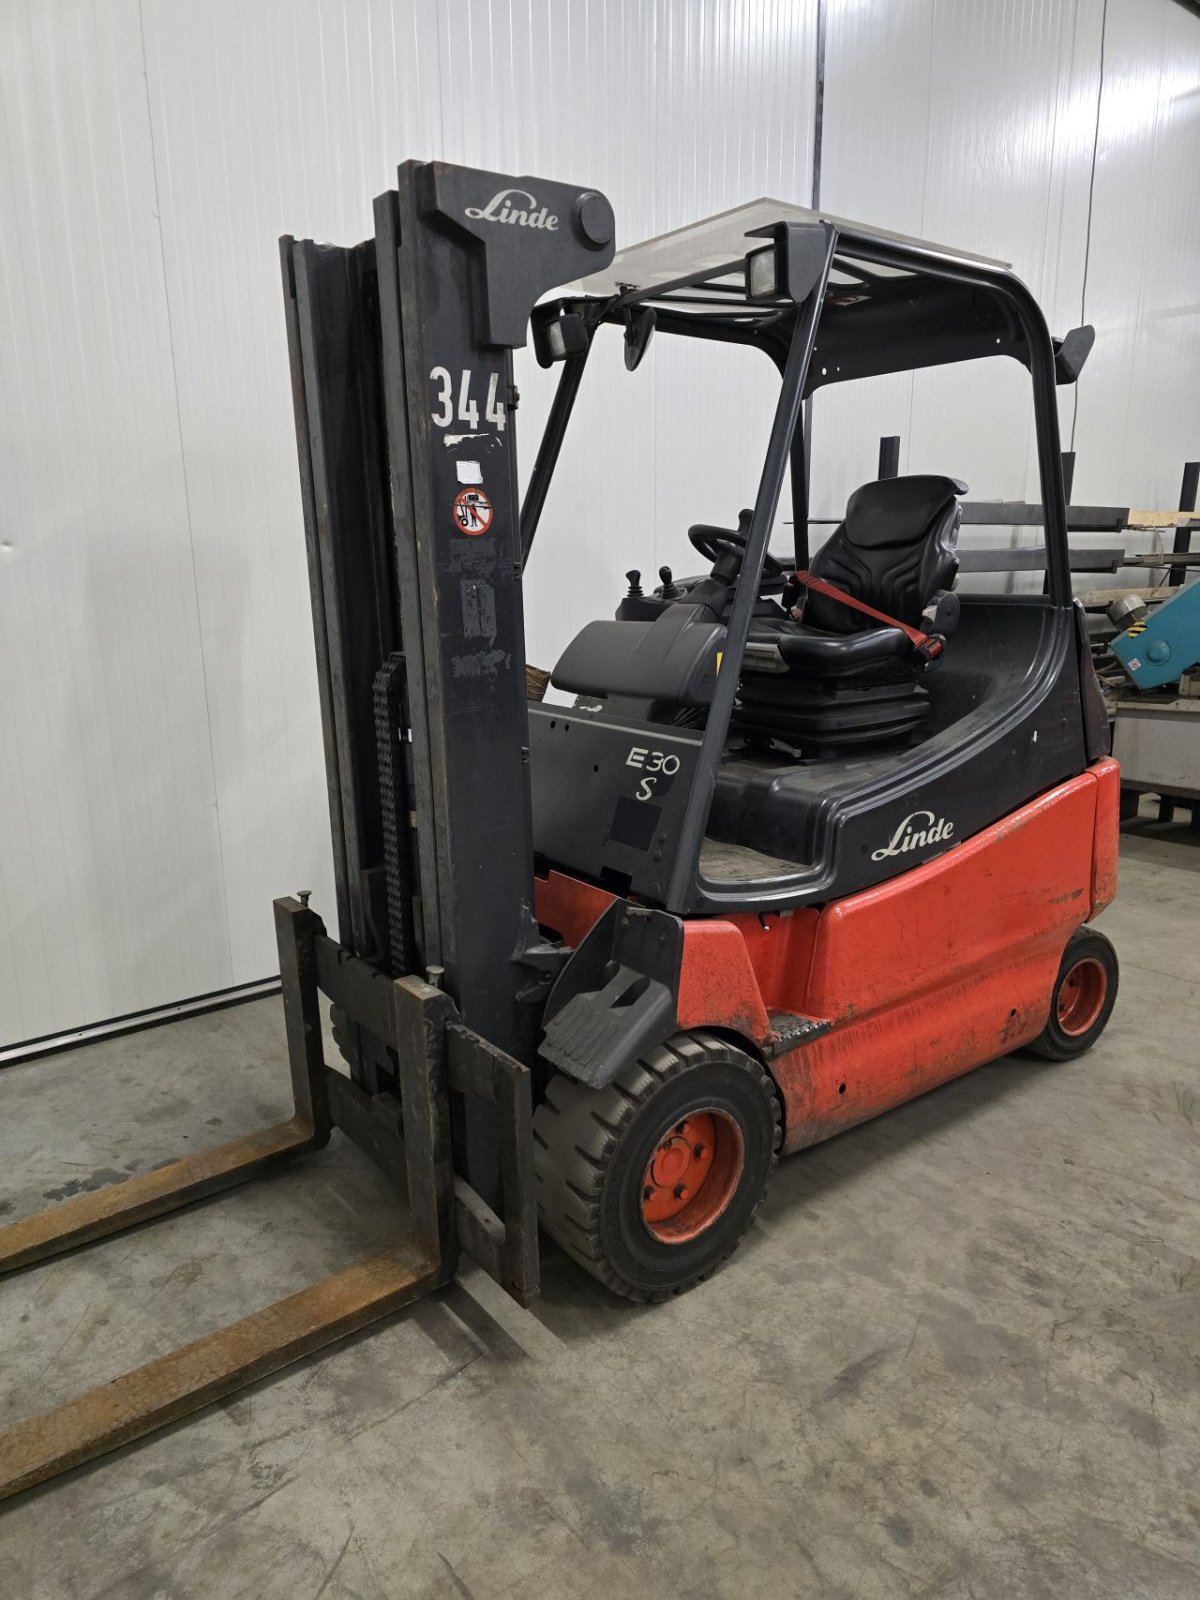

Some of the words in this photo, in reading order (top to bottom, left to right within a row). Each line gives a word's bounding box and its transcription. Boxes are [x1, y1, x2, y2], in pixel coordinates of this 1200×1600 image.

[465, 188, 560, 231] Linde
[429, 365, 507, 432] 344
[625, 746, 681, 775] E30
[635, 776, 658, 801] S
[870, 810, 954, 862] Linde
